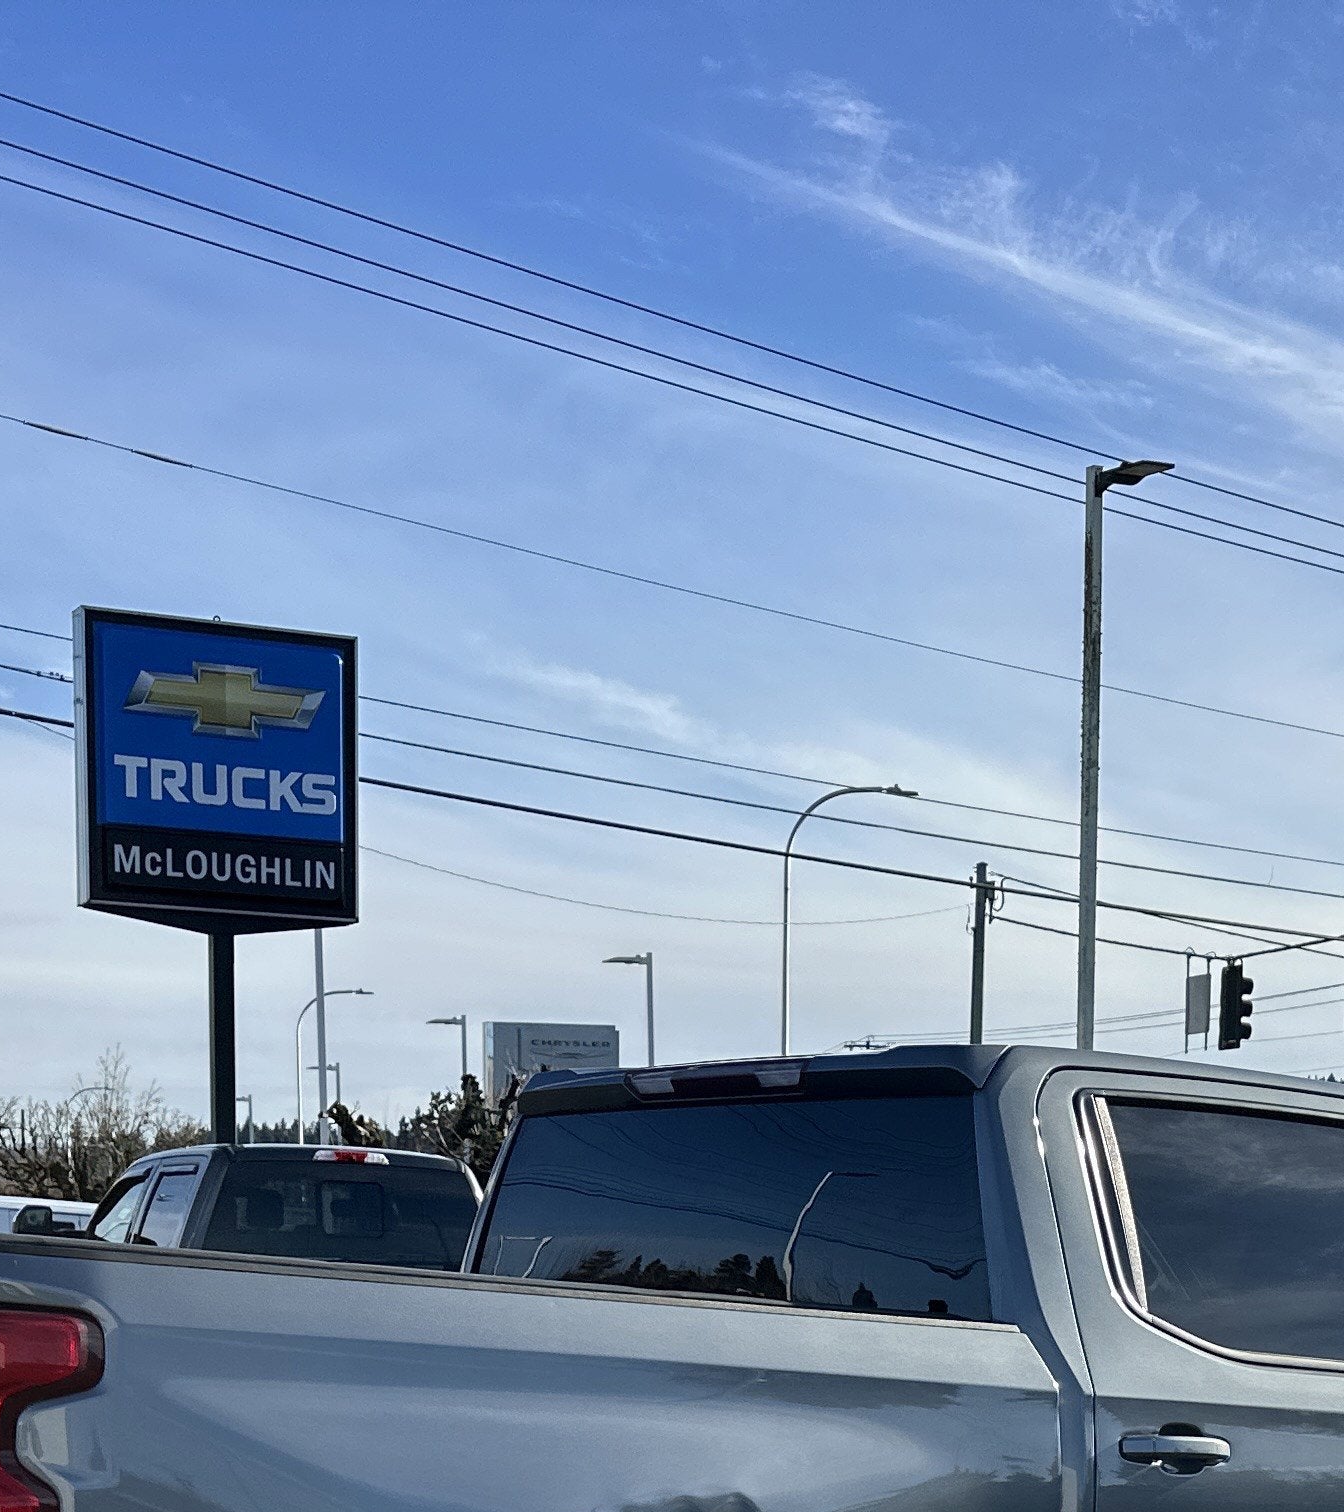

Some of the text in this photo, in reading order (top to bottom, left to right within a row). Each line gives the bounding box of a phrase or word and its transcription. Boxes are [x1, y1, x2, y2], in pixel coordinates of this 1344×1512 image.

[114, 753, 337, 816] TRUCKS
[114, 843, 336, 890] McLOUGHLIN
[531, 1038, 611, 1048] CHRYSLER
